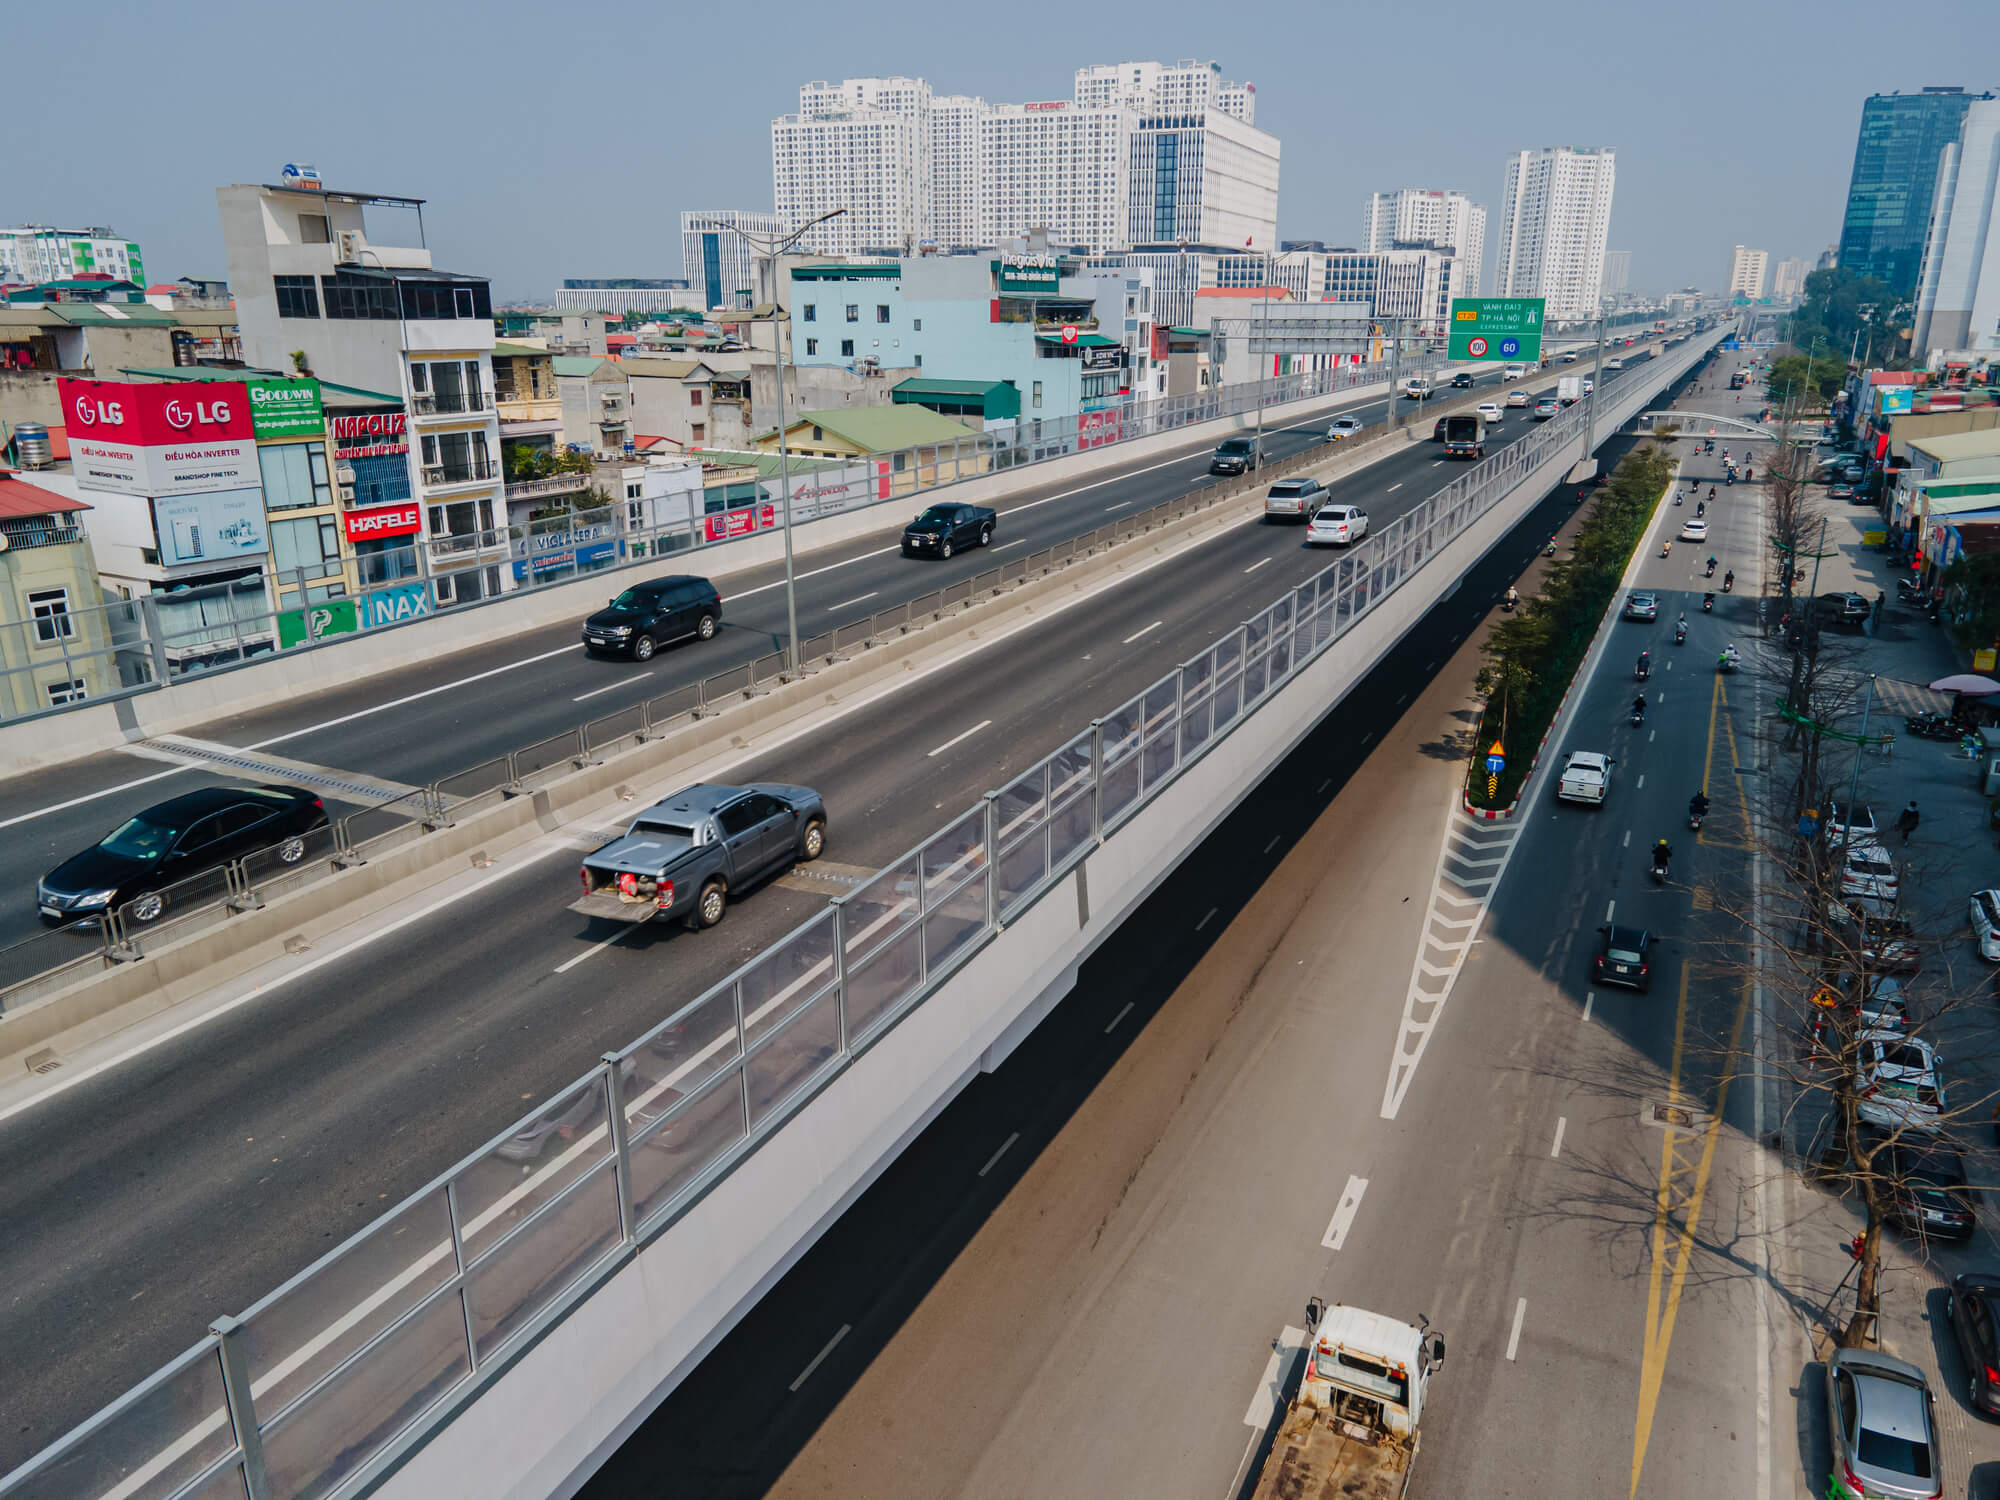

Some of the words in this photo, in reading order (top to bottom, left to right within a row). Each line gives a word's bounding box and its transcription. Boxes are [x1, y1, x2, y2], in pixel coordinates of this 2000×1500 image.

[1472, 342, 1485, 352] 100
[1503, 343, 1516, 353] 60
[251, 387, 313, 402] GOODWIN
[97, 400, 124, 425] LG
[196, 401, 231, 424] LG
[107, 451, 134, 461] INVERTER
[165, 450, 184, 462] ĐIỀU
[185, 449, 203, 460] HÒA
[204, 448, 240, 459] INVERTER
[174, 472, 210, 482] BRANDSHOP
[210, 471, 223, 479] FINE
[223, 470, 239, 478] TECH
